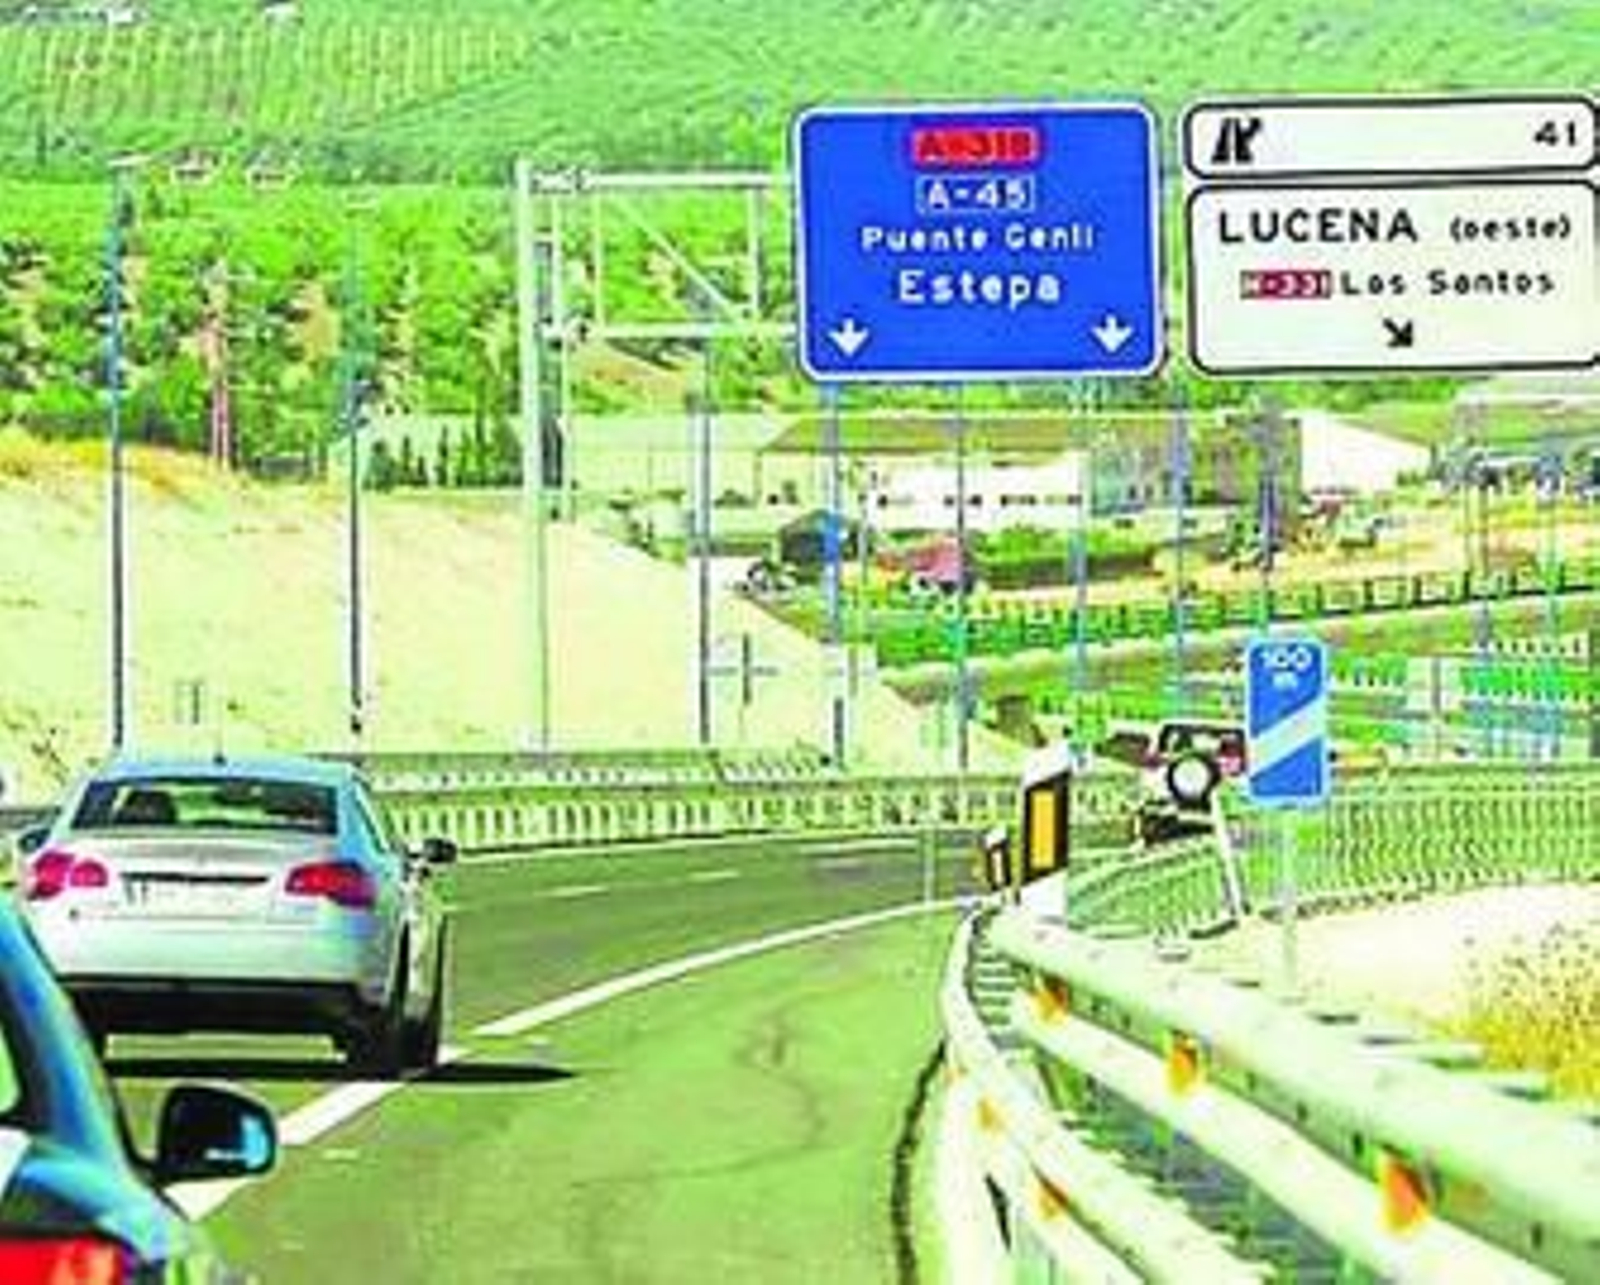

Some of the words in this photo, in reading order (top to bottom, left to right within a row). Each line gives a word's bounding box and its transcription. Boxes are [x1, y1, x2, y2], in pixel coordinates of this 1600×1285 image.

[1533, 120, 1577, 147] 41
[929, 183, 1026, 210] A-45
[860, 225, 989, 251] Puente
[1218, 208, 1418, 244] LUCENA
[1449, 214, 1571, 243] (oeste)
[899, 268, 1061, 311] Estepa
[1341, 270, 1408, 296] Los
[1428, 268, 1556, 296] Santos
